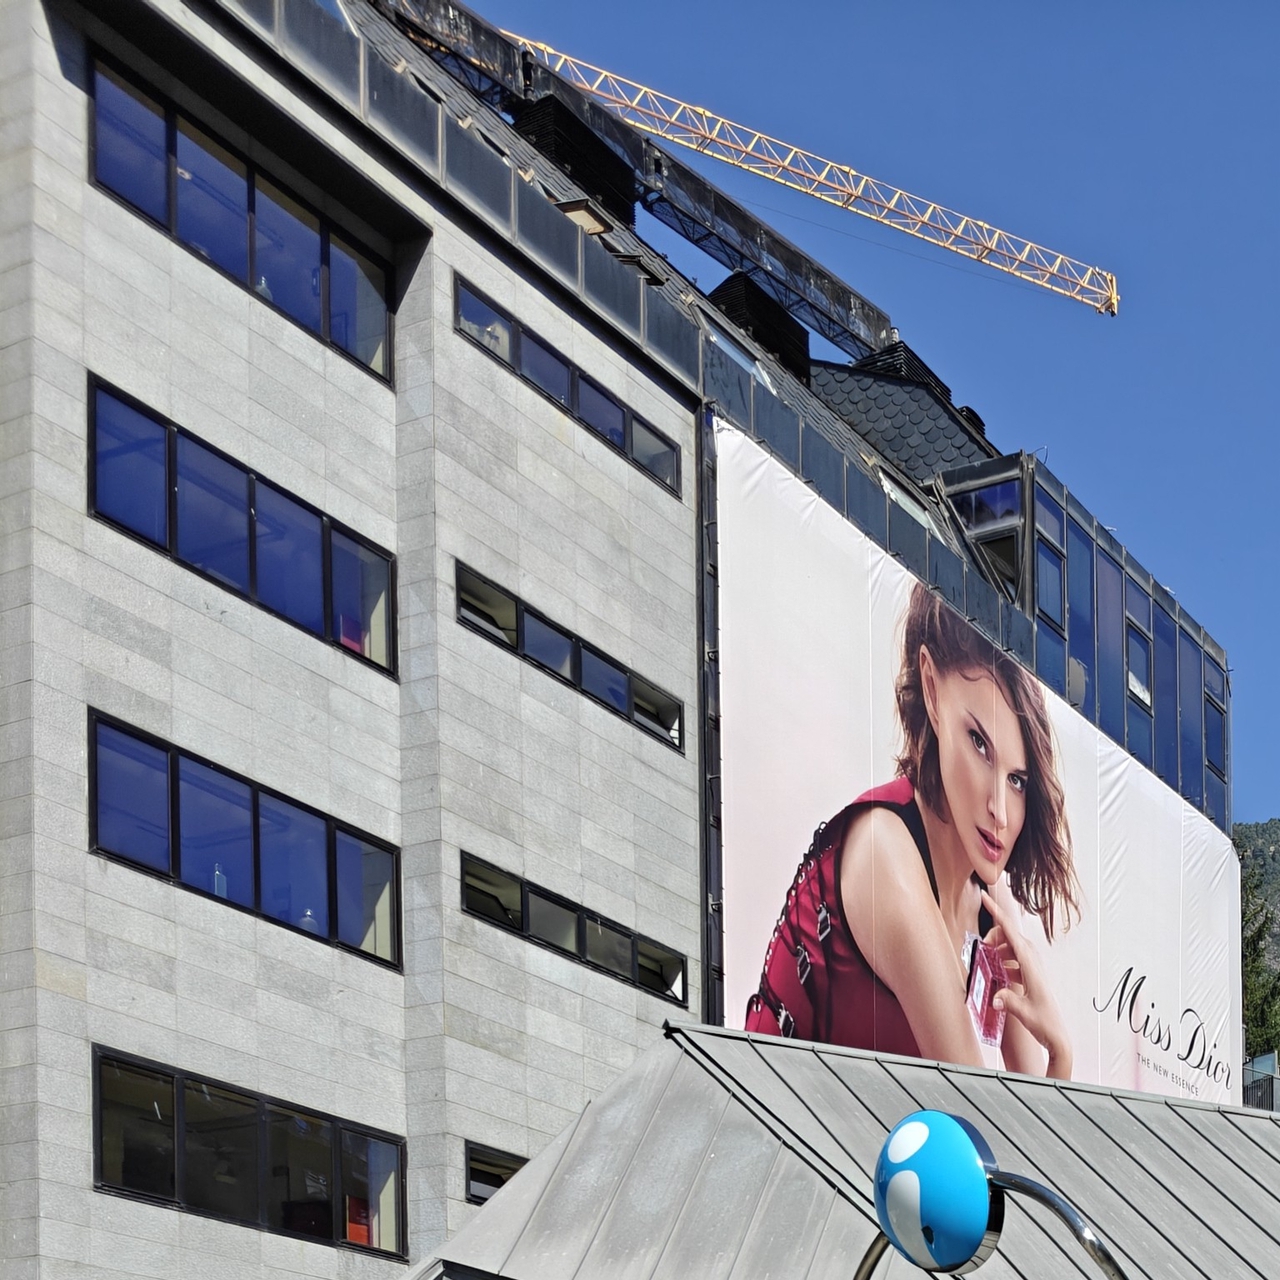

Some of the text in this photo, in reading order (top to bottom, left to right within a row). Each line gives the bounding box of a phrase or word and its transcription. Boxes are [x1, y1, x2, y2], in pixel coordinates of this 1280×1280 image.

[1093, 966, 1232, 1090] Miss Dior
[1137, 1053, 1199, 1096] THE NEW ESSENCE
